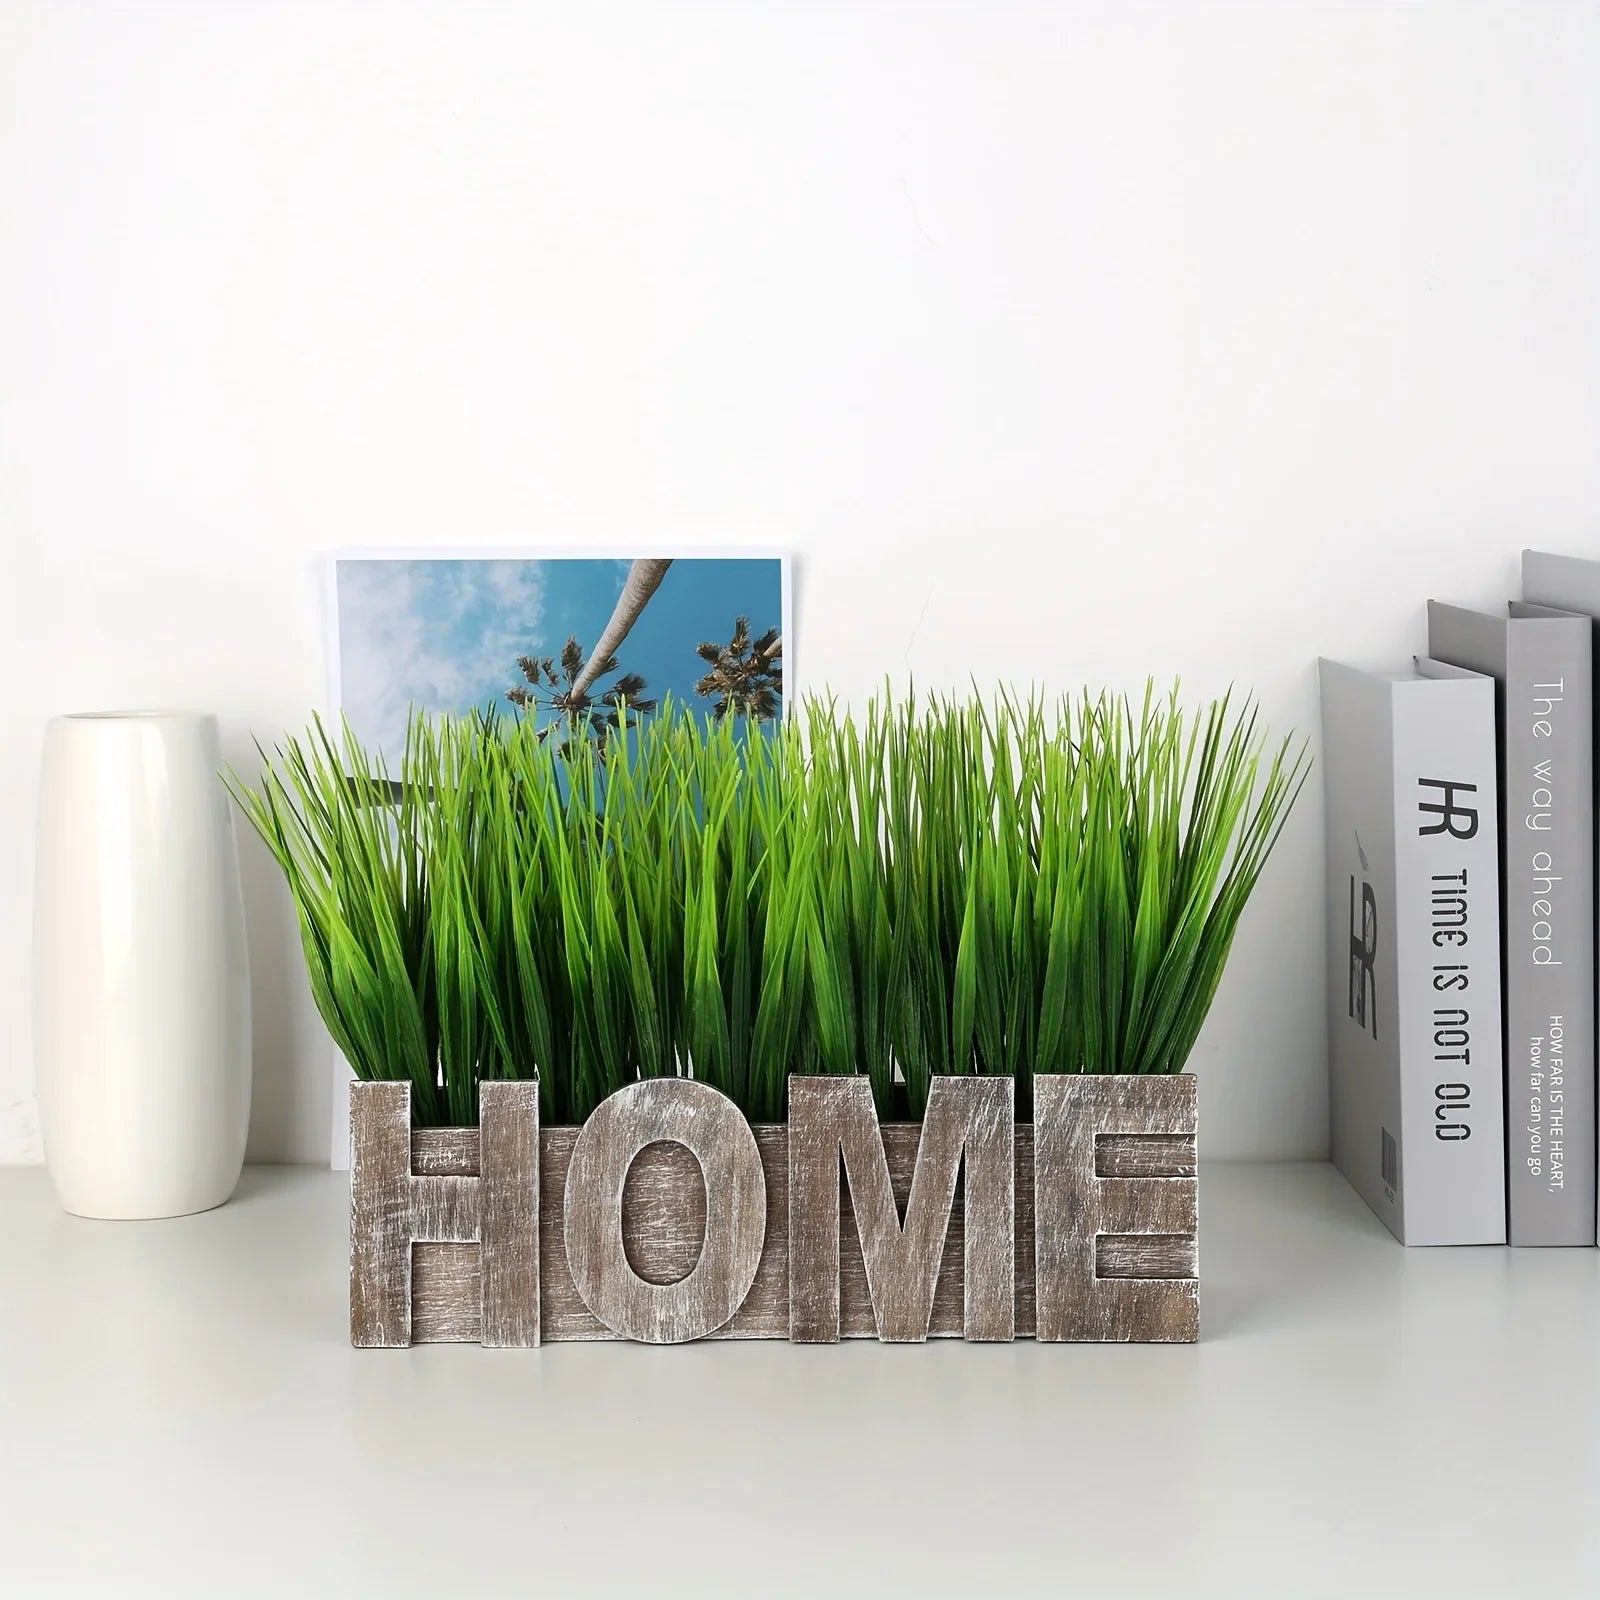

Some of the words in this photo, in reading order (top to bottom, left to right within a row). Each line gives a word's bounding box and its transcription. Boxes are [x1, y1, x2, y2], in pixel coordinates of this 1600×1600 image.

[1532, 676, 1564, 738] The
[1417, 777, 1479, 840] HR
[1525, 758, 1552, 831] way
[1532, 851, 1563, 965] ahead
[1530, 1036, 1545, 1069] how
[1549, 1015, 1564, 1054] HOW
[1530, 1072, 1545, 1093] far
[1549, 1058, 1564, 1086] FAR
[1434, 1083, 1472, 1141] OLD
[1530, 1096, 1542, 1123] can
[1549, 1090, 1564, 1103] IS
[1549, 1106, 1564, 1136] THE
[1526, 1125, 1542, 1154] you
[1526, 1157, 1542, 1176] go
[1548, 1140, 1564, 1193] HEART,
[350, 1073, 1199, 1348] HOME
